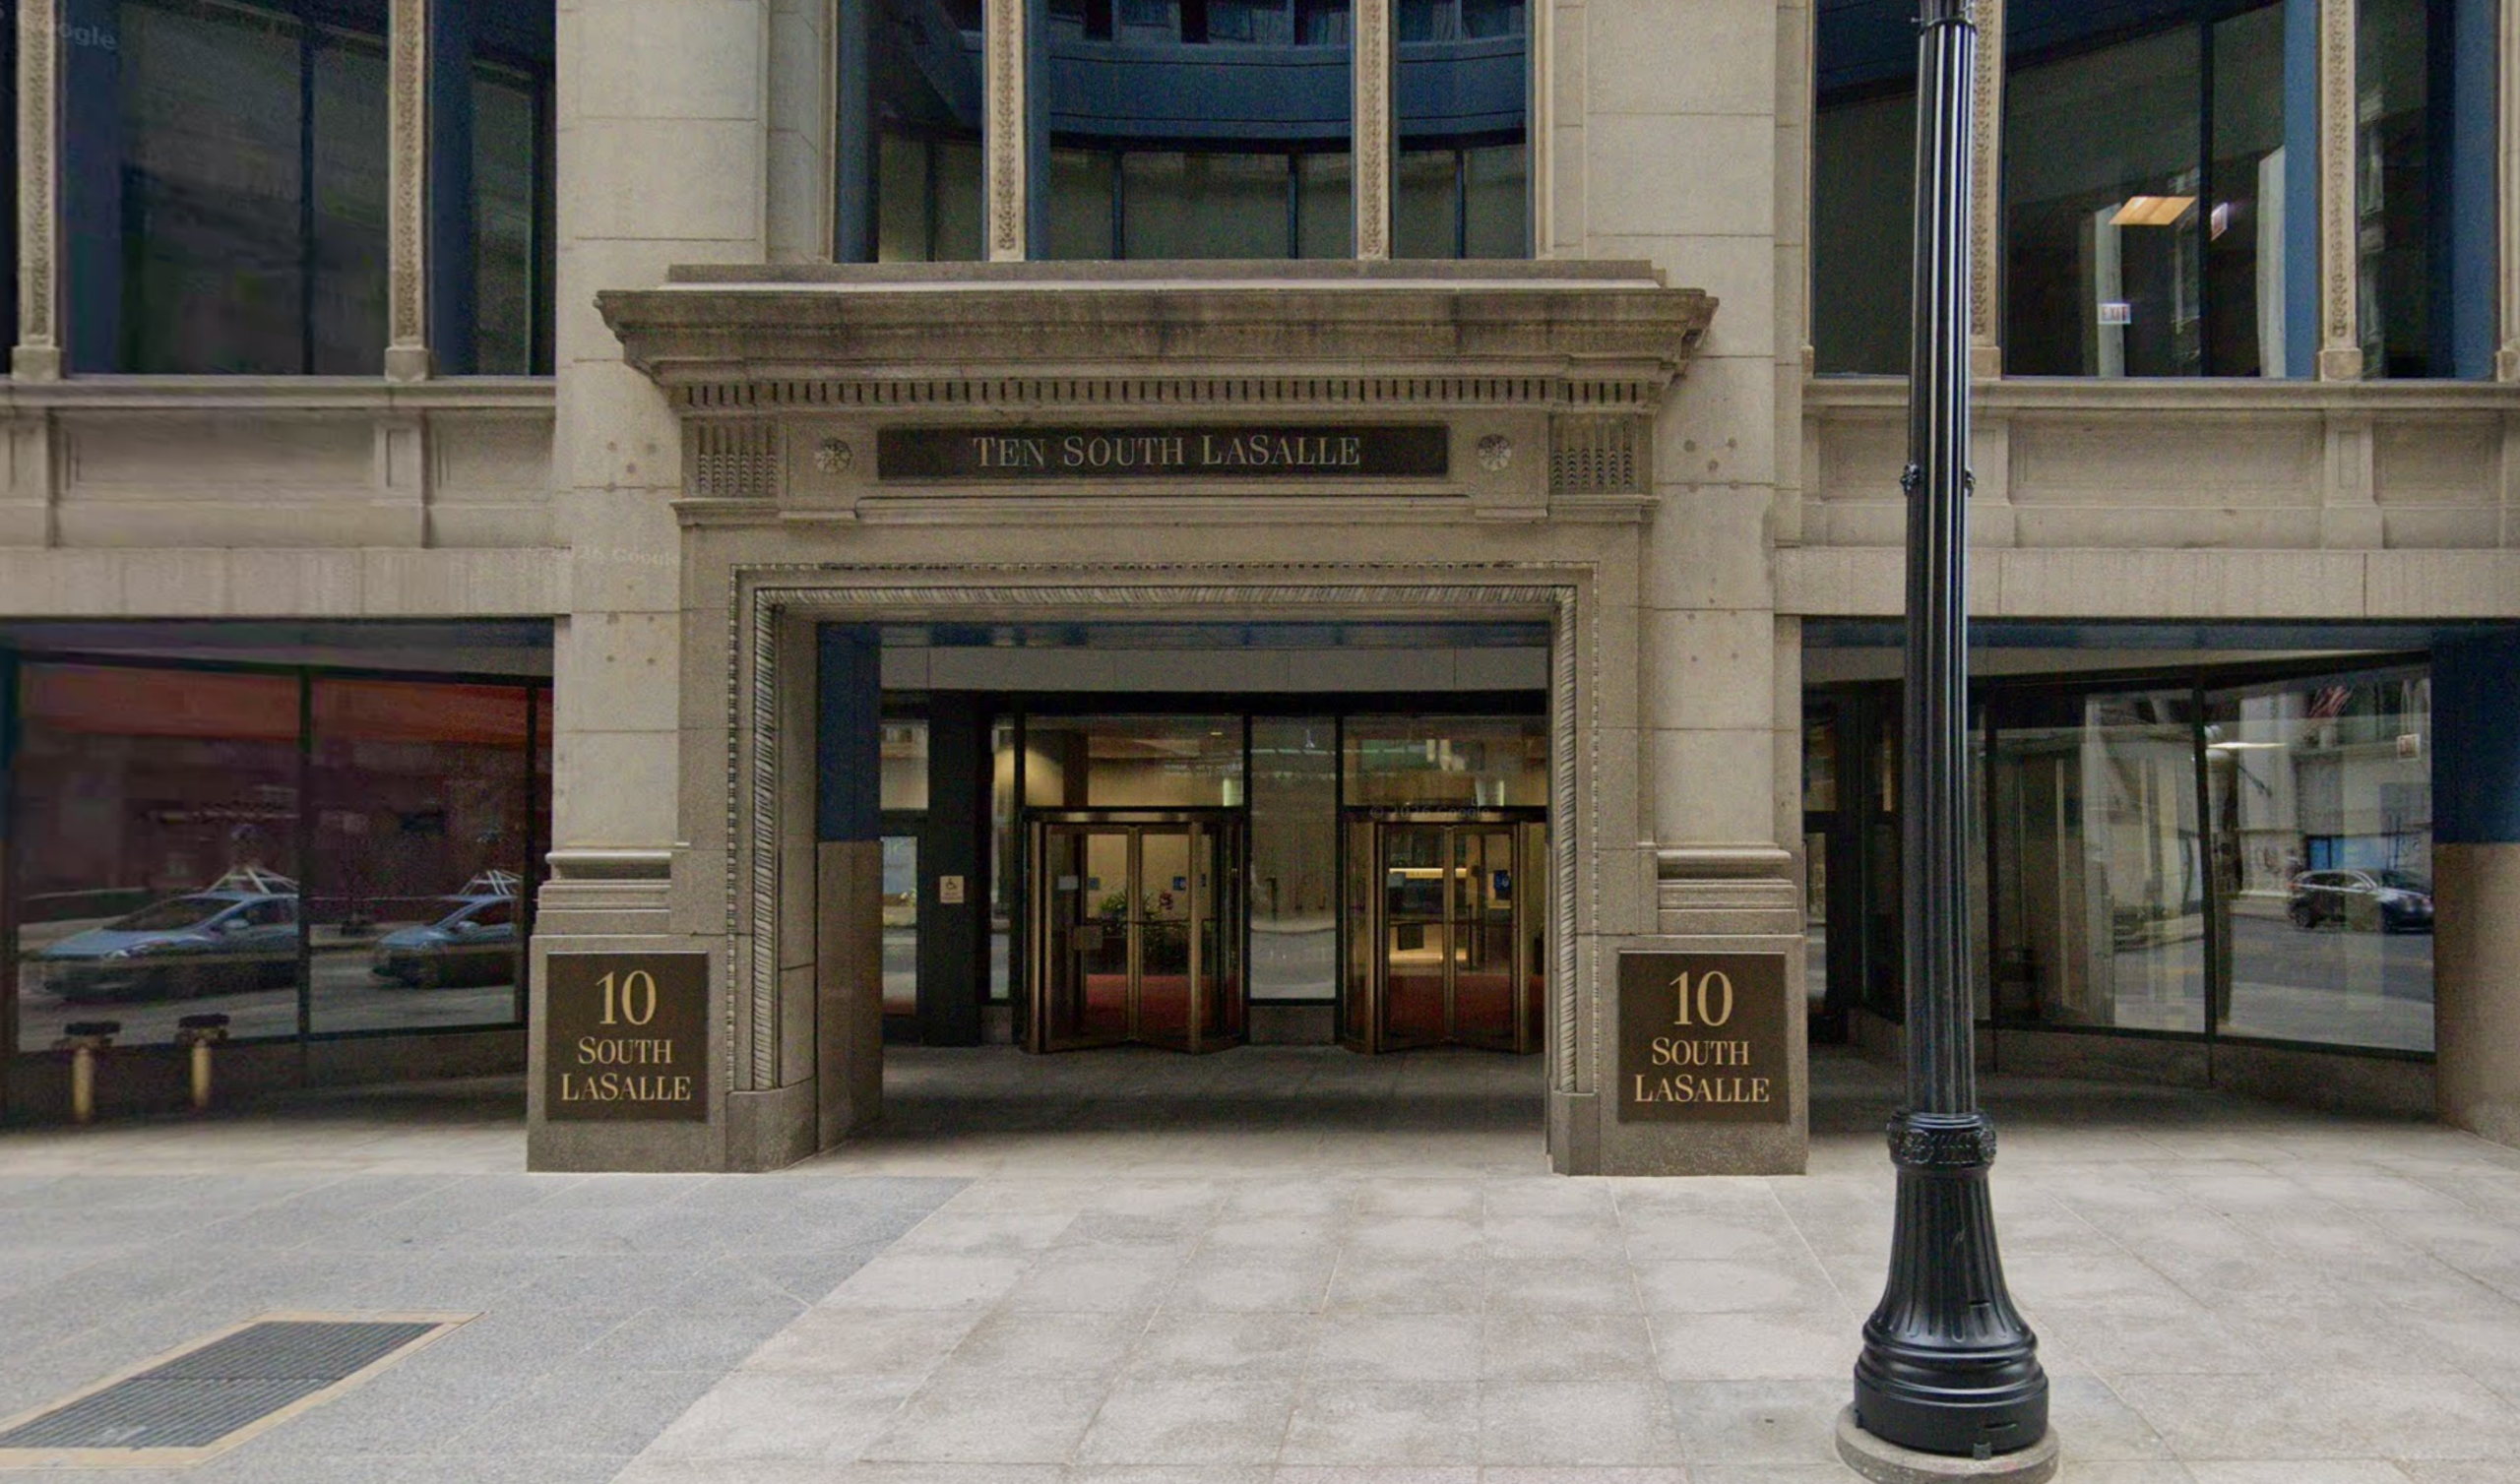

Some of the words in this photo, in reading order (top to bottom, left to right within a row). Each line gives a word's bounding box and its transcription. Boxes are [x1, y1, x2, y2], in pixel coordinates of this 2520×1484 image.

[973, 437, 1044, 467] TEN
[1063, 436, 1184, 466] SOUTH
[596, 969, 657, 1025] 10
[1669, 969, 1734, 1027] 10
[578, 1036, 672, 1064] SOUTH
[1651, 1037, 1749, 1066] SOUTH
